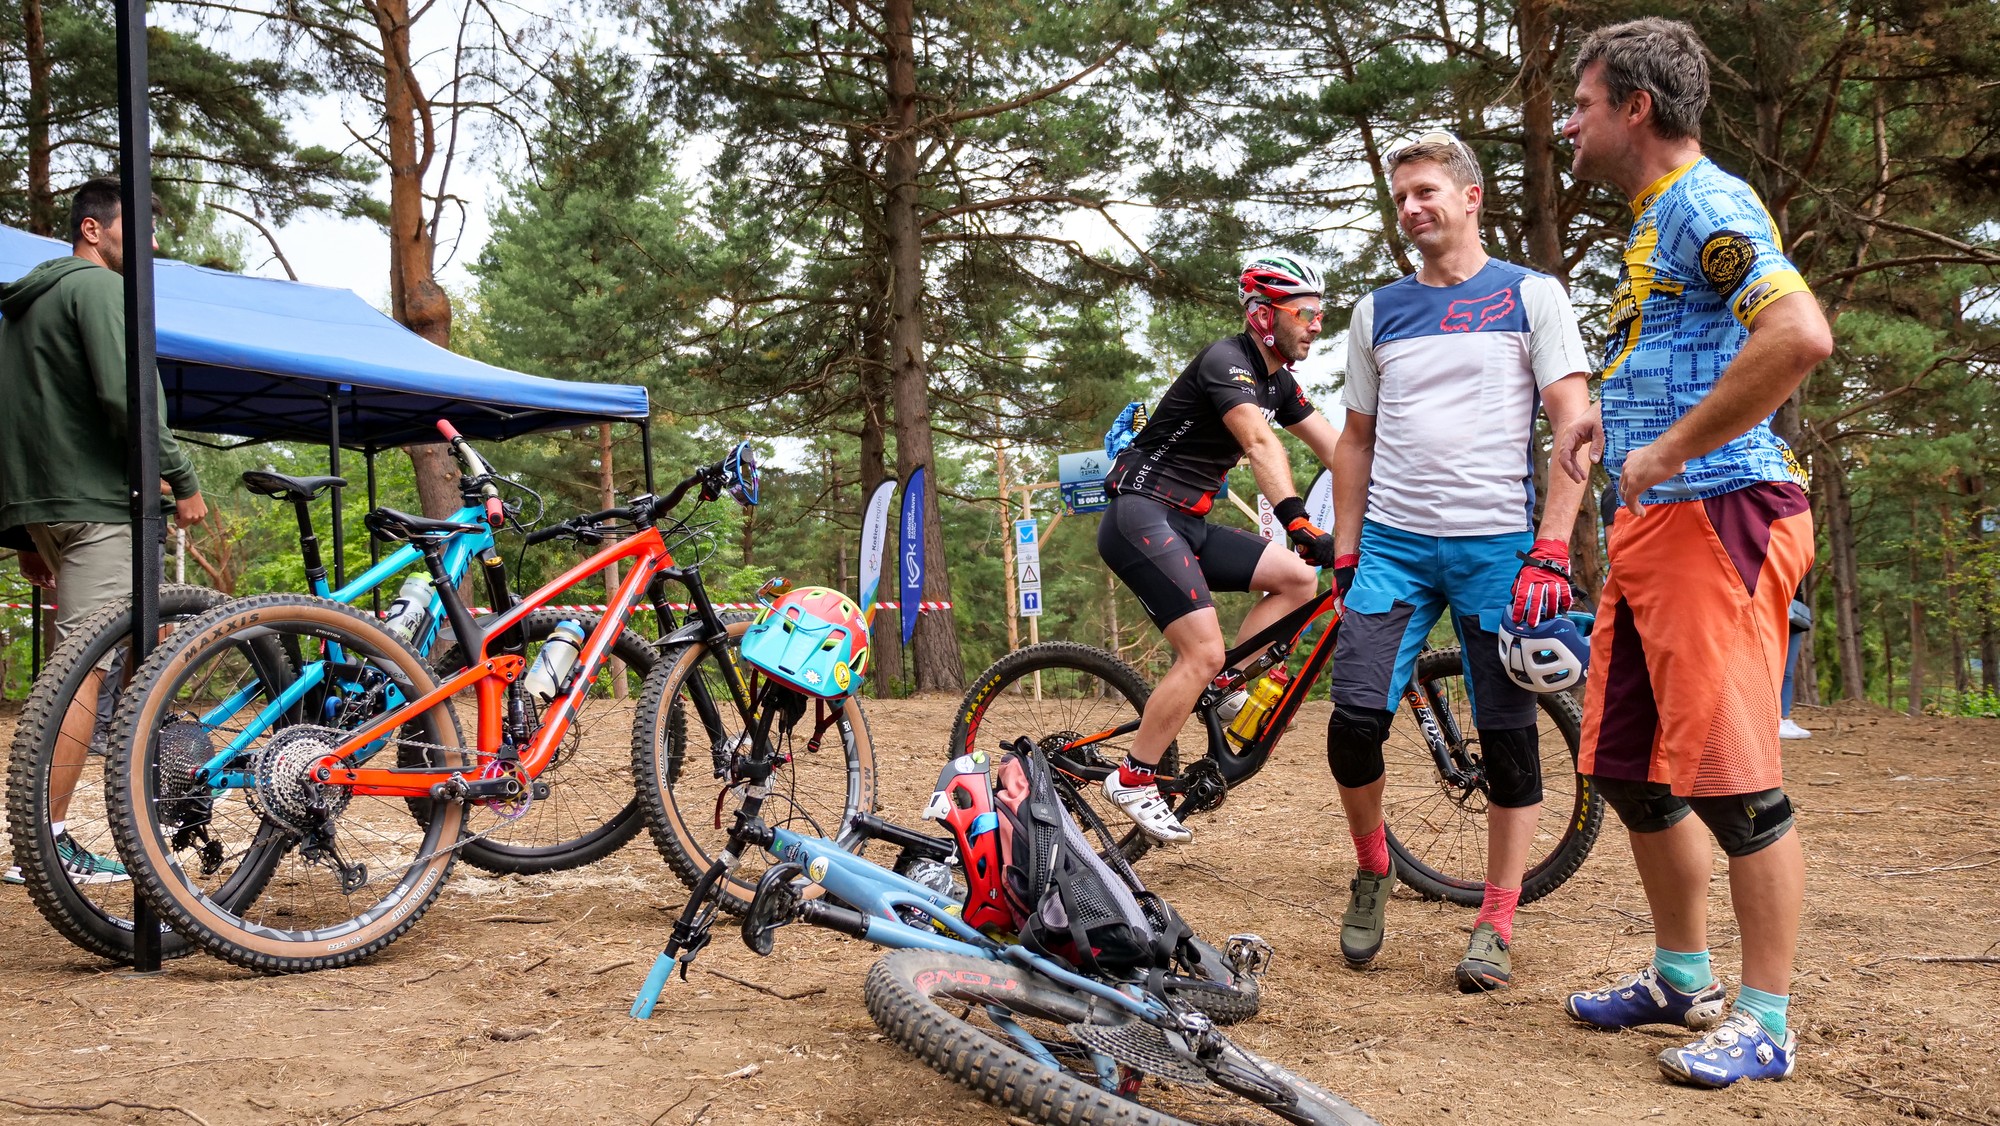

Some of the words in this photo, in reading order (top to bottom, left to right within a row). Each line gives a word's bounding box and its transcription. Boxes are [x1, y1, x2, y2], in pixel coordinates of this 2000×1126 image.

[1132, 464, 1153, 490] GORE
[1085, 496, 1099, 504] 000
[183, 613, 260, 663] MAXXIS
[965, 674, 1001, 724] MAXXIS
[1417, 708, 1446, 751] FOX
[1577, 777, 1589, 831] AXXIS
[410, 867, 439, 904] MINION
